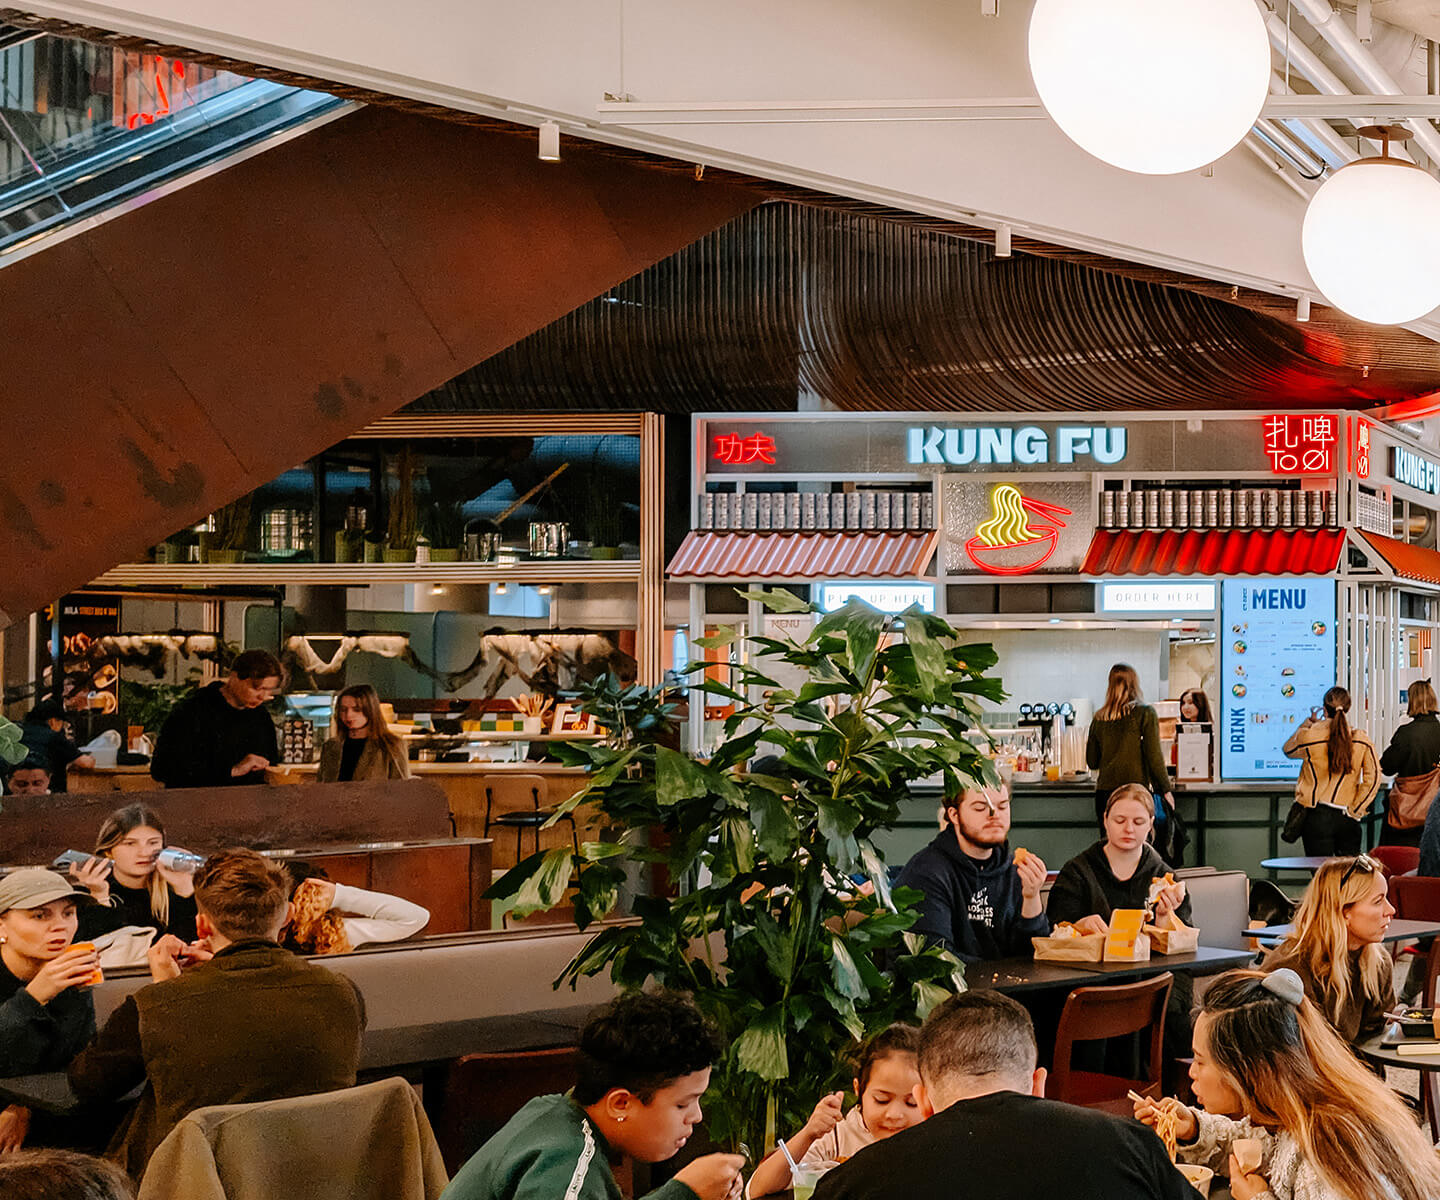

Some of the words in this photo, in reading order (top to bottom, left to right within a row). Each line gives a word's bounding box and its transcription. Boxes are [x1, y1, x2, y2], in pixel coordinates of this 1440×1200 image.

[714, 433, 775, 464] 功夫
[907, 426, 1048, 465] KUNG
[1057, 427, 1127, 464] FU
[1264, 415, 1335, 449] 扎啤
[1394, 446, 1426, 491] KUNG
[1425, 460, 1440, 496] FU
[1252, 588, 1306, 610] MENU
[1230, 707, 1246, 753] DRINK
